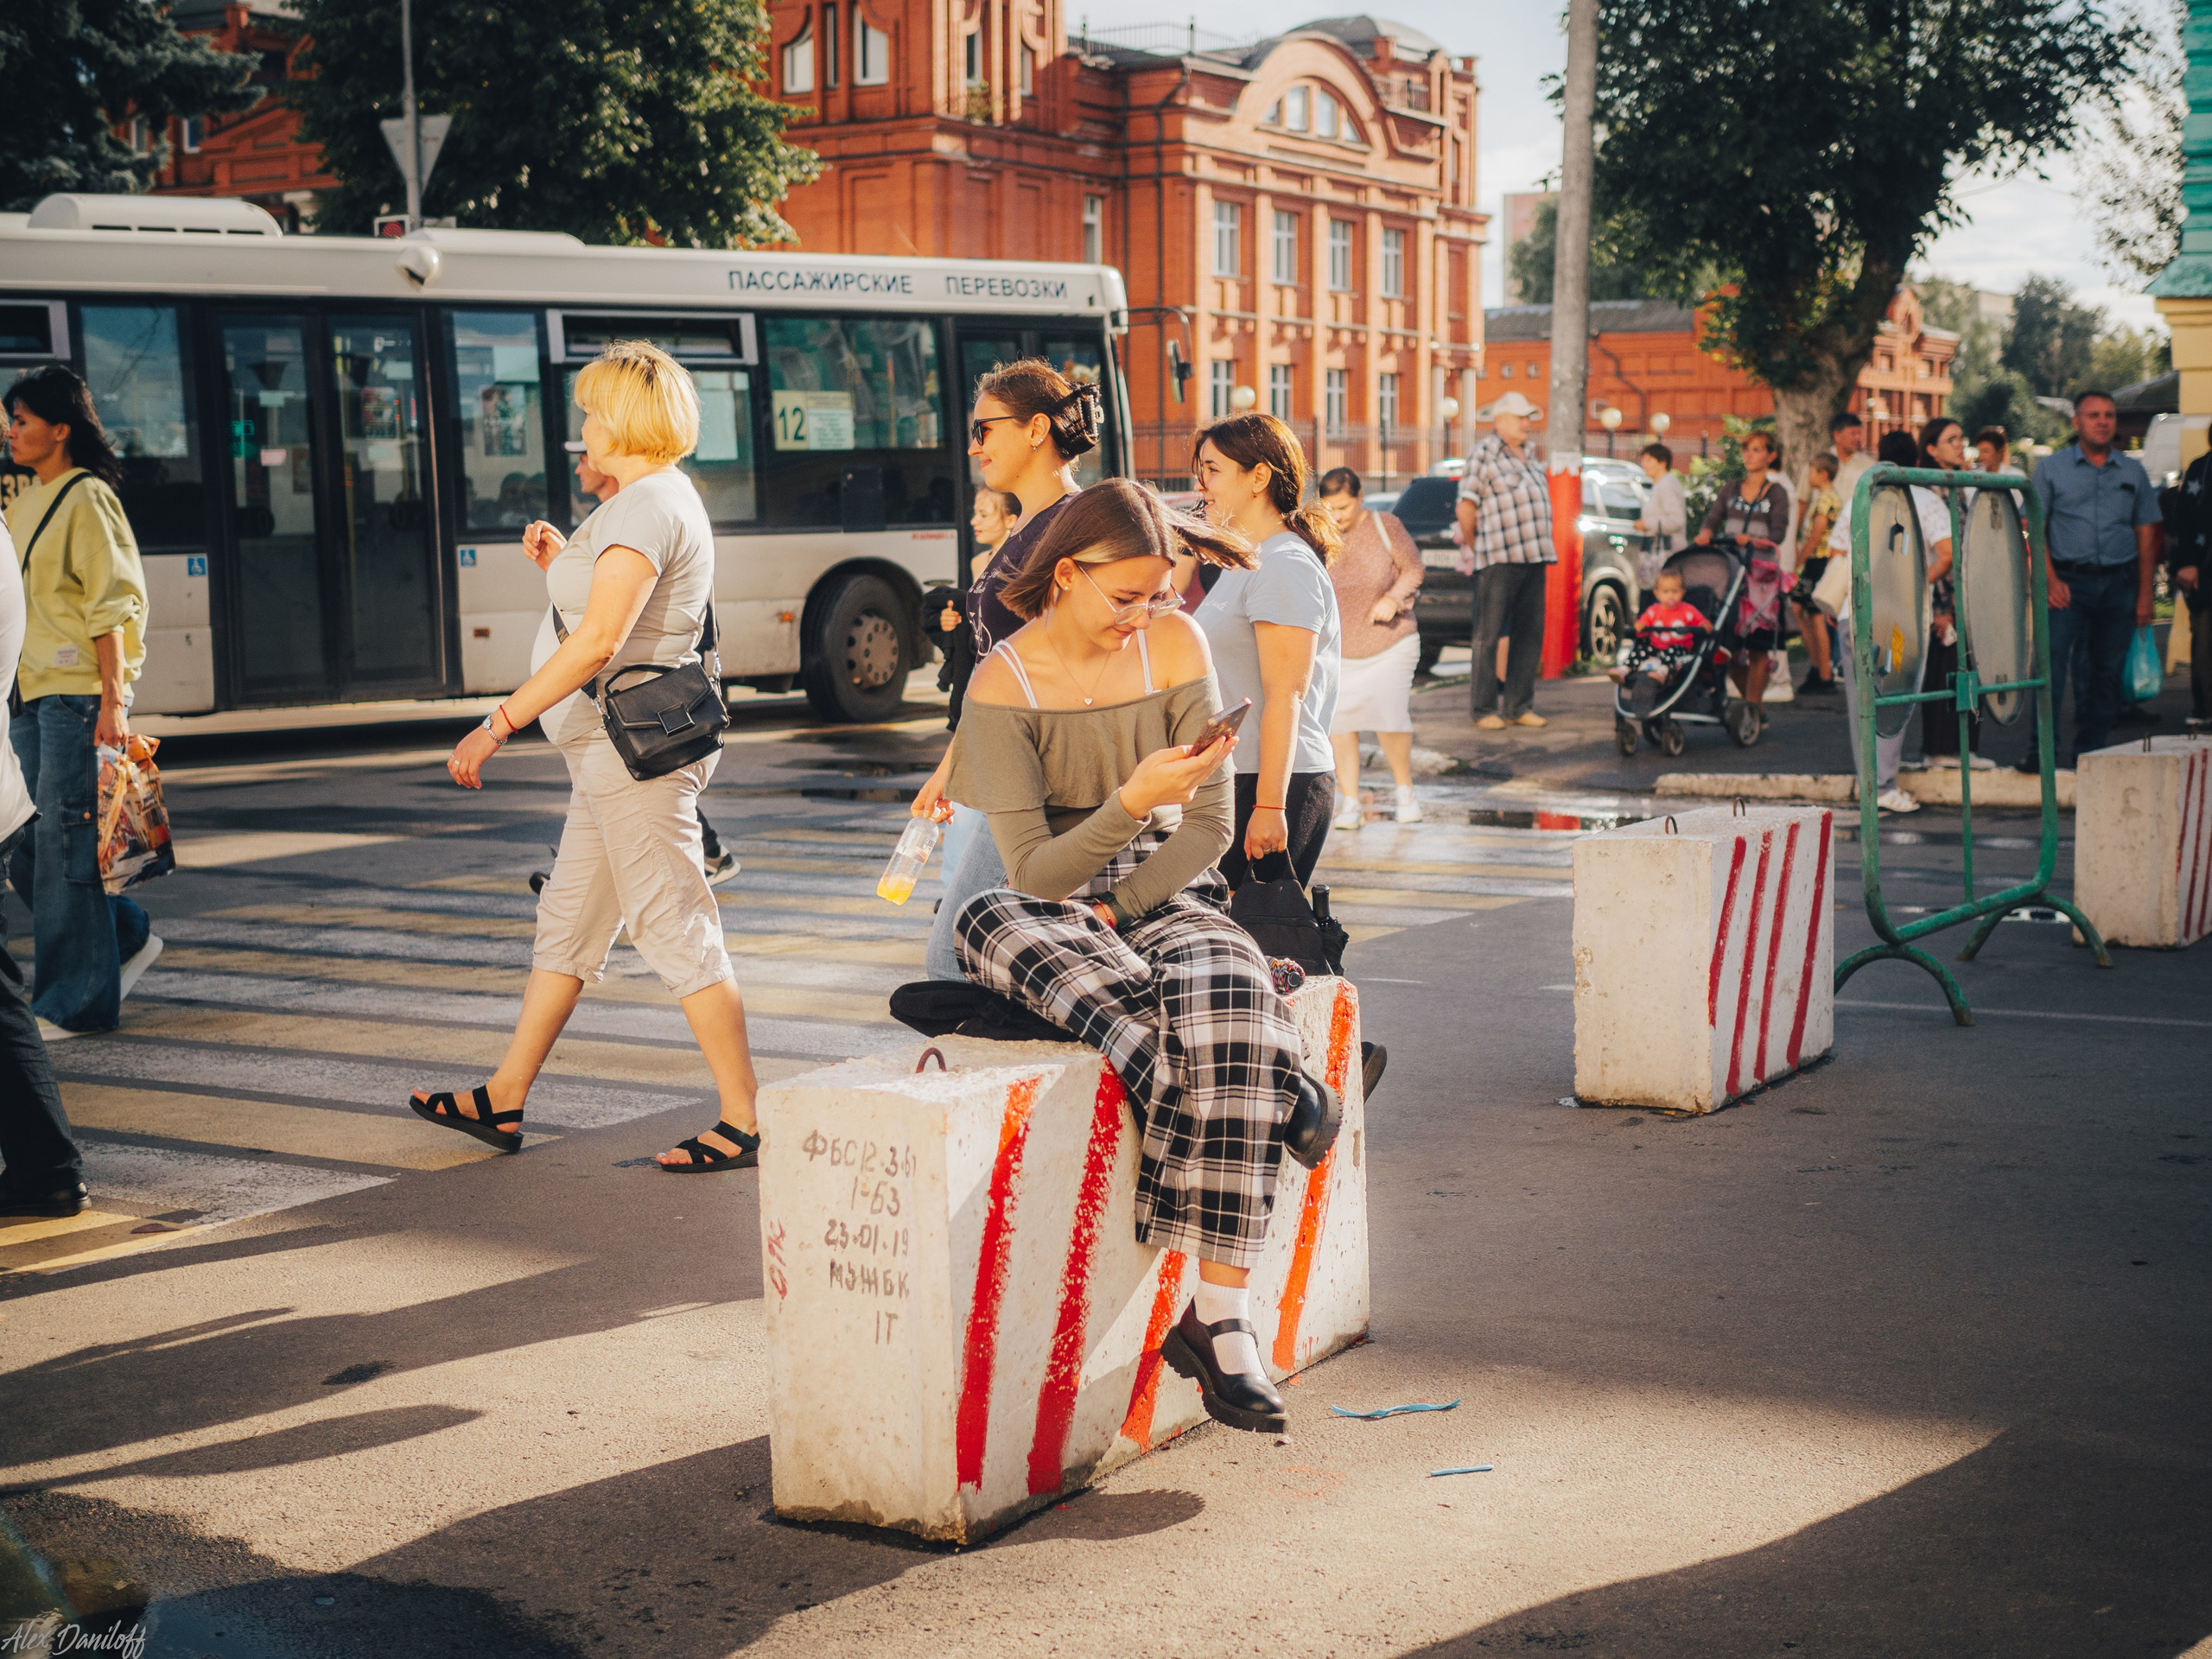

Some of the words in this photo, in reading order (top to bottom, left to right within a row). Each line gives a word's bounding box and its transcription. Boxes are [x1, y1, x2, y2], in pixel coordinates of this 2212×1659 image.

[728, 270, 913, 295] ПАССАЖИРСКИЕ
[946, 276, 1068, 299] ПЕРЕВОЗКИ
[779, 406, 805, 441] 12
